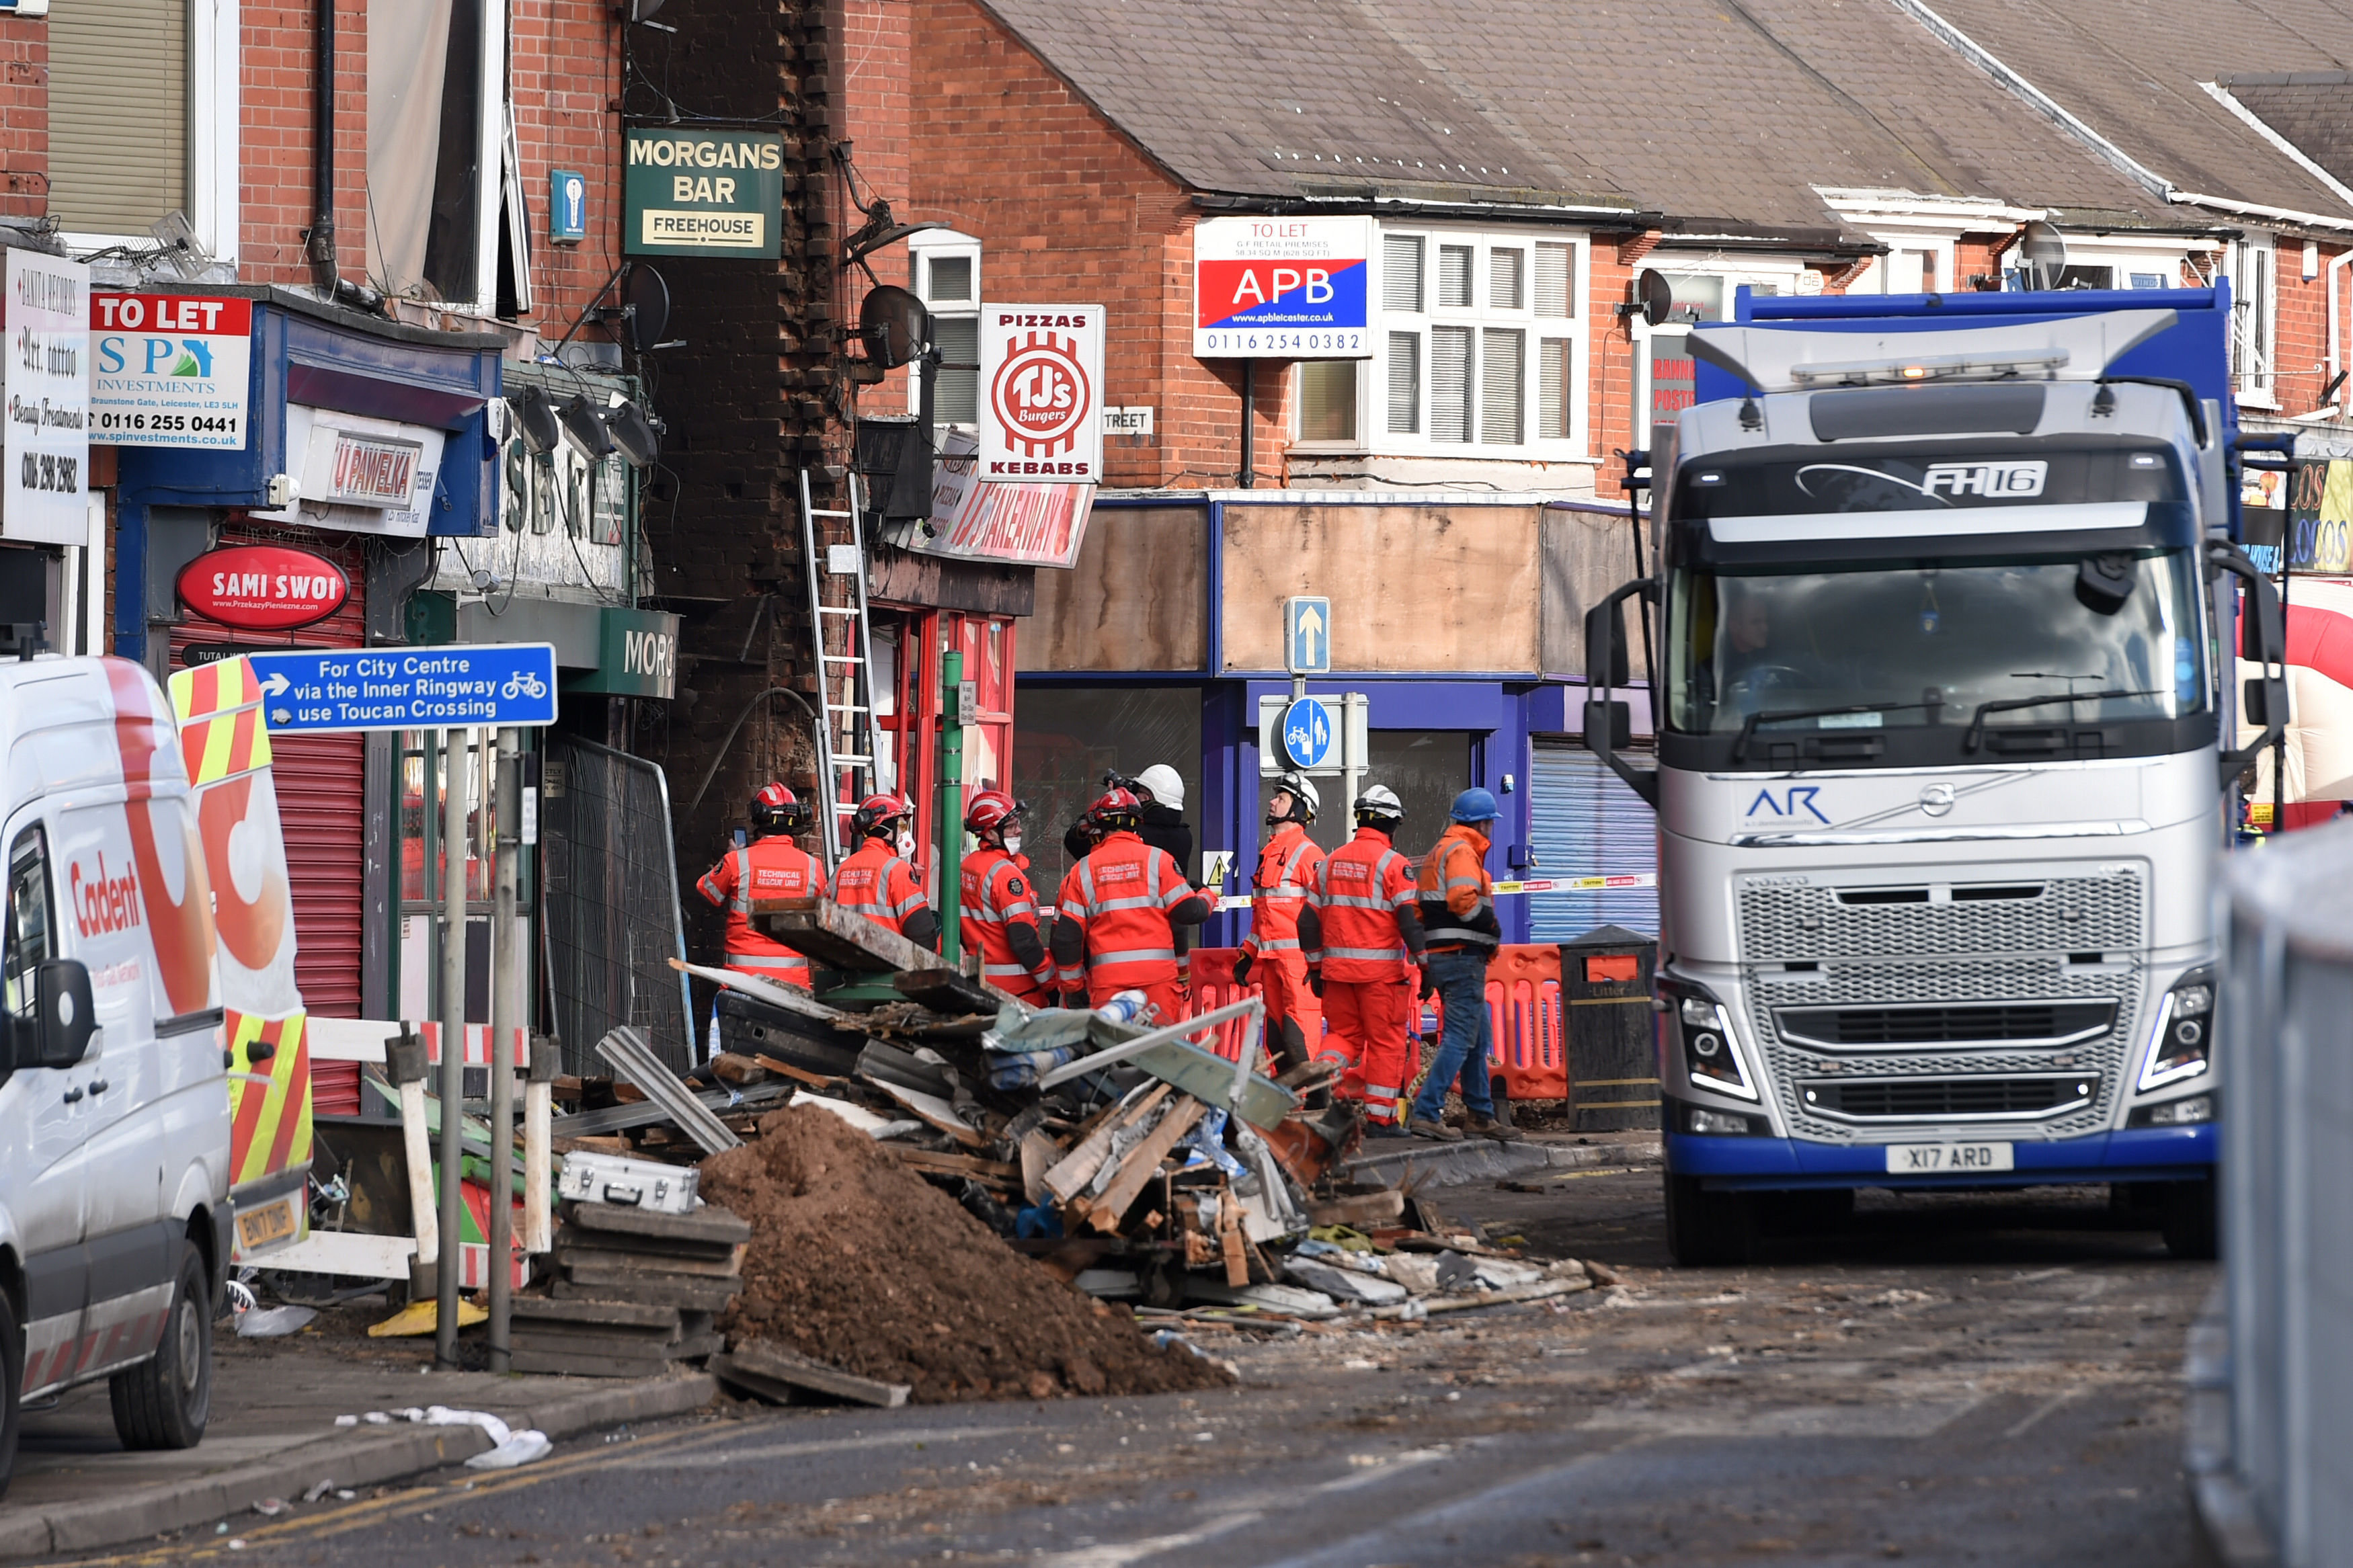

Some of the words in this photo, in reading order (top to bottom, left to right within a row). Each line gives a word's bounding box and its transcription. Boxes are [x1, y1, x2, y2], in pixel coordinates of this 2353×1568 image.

[629, 139, 781, 169] MORGANS
[673, 175, 735, 204] BAR
[653, 217, 754, 234] FREEHOUSE
[1251, 224, 1273, 237] TO
[1279, 224, 1308, 237] LET
[1232, 268, 1334, 304] APB
[99, 298, 145, 328] TO
[156, 300, 223, 331] LET
[999, 314, 1086, 328] PIZZAS
[1232, 312, 1334, 324] www.apbleicester.co.uk
[1207, 334, 1257, 349] 0116
[1266, 334, 1300, 349] 254
[1310, 333, 1359, 349] 0382
[47, 333, 77, 380] tattoo
[97, 379, 215, 394] INVESTMENTS
[1012, 365, 1072, 408] TJ's
[91, 397, 134, 406] Braunstone
[137, 398, 159, 407] Gate,
[161, 399, 202, 409] Leicester,
[222, 401, 238, 409] 5LH
[13, 394, 40, 436] Beauty
[41, 397, 83, 430] Treatments
[102, 412, 145, 429] 0116
[151, 415, 185, 430] 255
[191, 416, 236, 432] 0441
[1018, 409, 1066, 424] Burgers
[990, 462, 1089, 474] KEBABS
[212, 572, 267, 597] SAMI
[275, 575, 336, 600] SWOI
[319, 660, 350, 678] For
[356, 658, 397, 679] City
[403, 656, 470, 675] Centre
[294, 683, 321, 700] via
[327, 682, 358, 699] the
[364, 680, 410, 698] Inner
[415, 678, 497, 698] Ringway
[298, 707, 332, 722] use
[337, 702, 405, 720] Toucan
[411, 699, 497, 718] Crossing
[1745, 786, 1832, 825] AR
[758, 869, 801, 879] TECHNICAL
[71, 849, 141, 938] Cadent
[1908, 1147, 1942, 1168] X17
[1950, 1147, 1992, 1167] ARD
